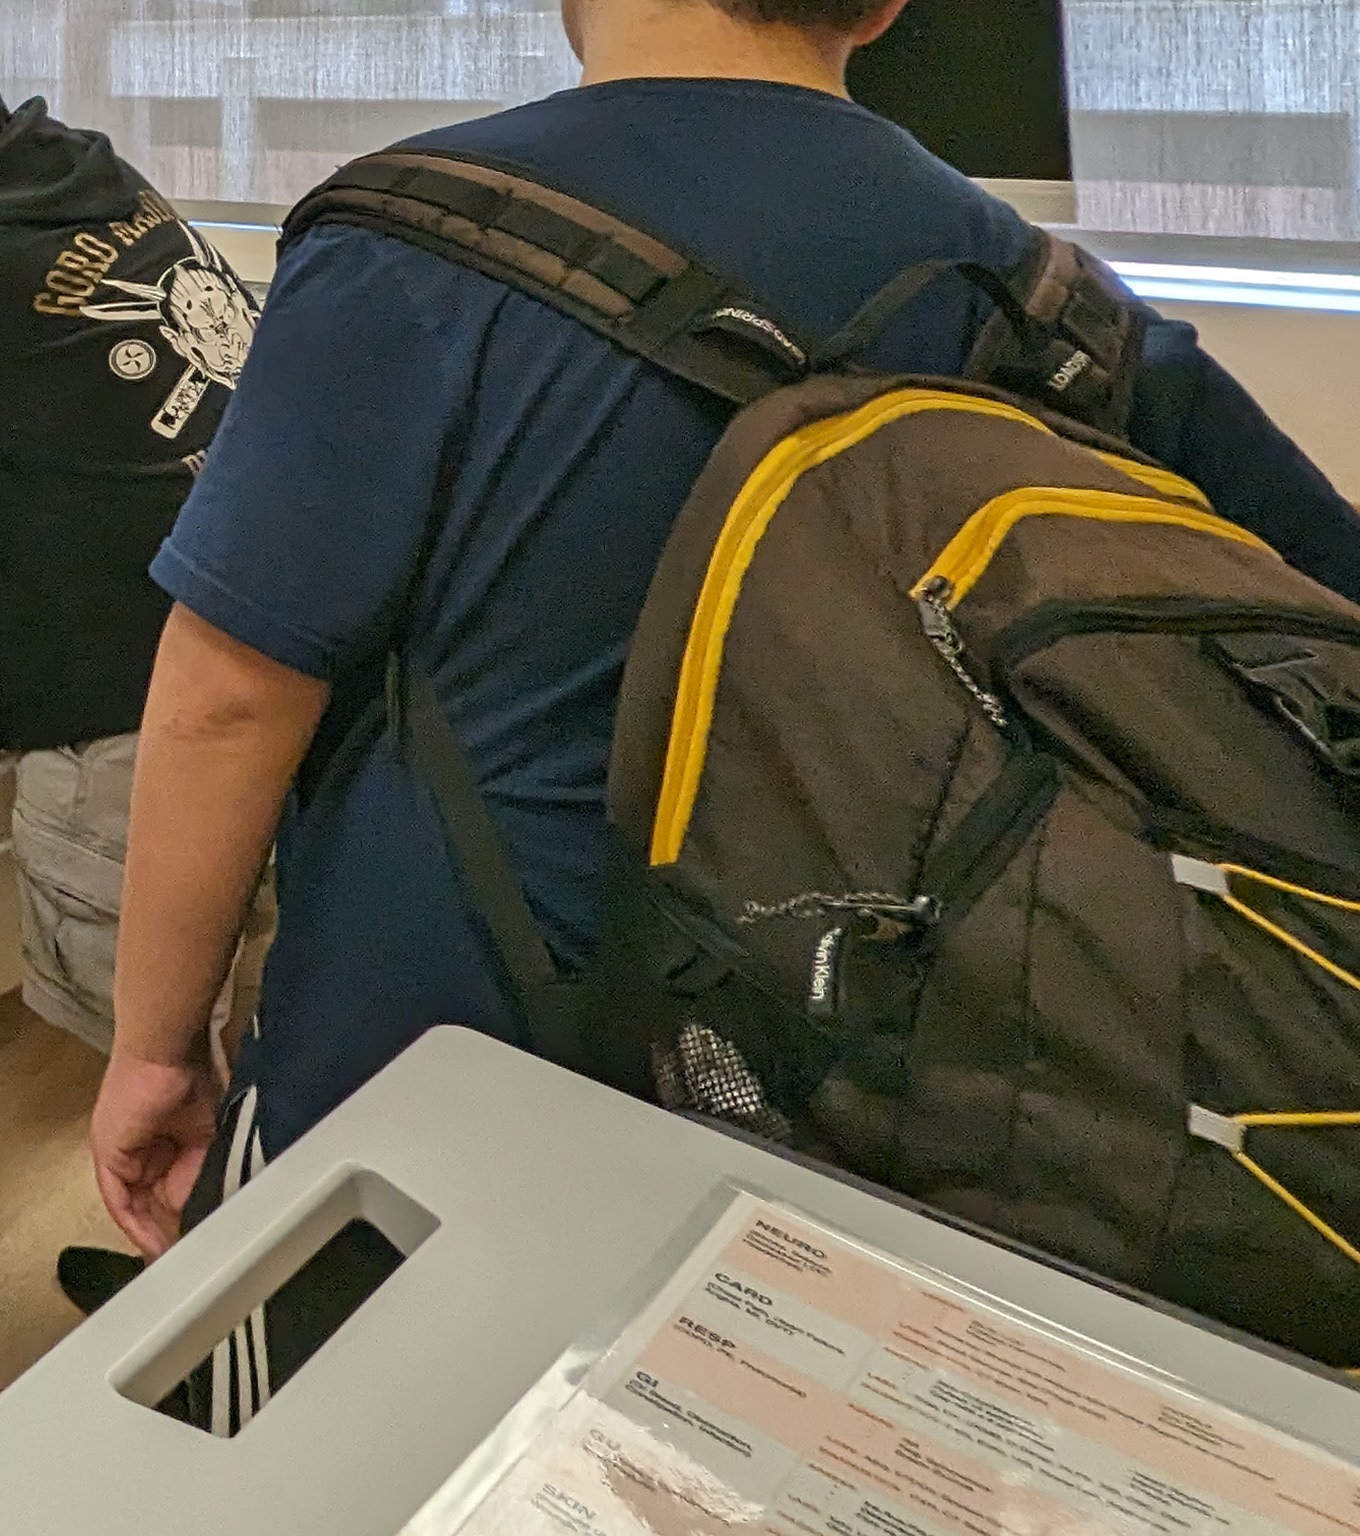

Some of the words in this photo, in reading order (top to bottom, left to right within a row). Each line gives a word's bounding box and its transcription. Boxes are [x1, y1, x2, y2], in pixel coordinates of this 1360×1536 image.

[33, 232, 120, 318] GORO
[811, 965, 830, 1000] Klein
[754, 1219, 828, 1260] NEURO
[713, 1271, 775, 1307] CARD
[678, 1315, 737, 1349] RESP
[635, 1370, 660, 1389] GI
[542, 1482, 598, 1521] SKIN
